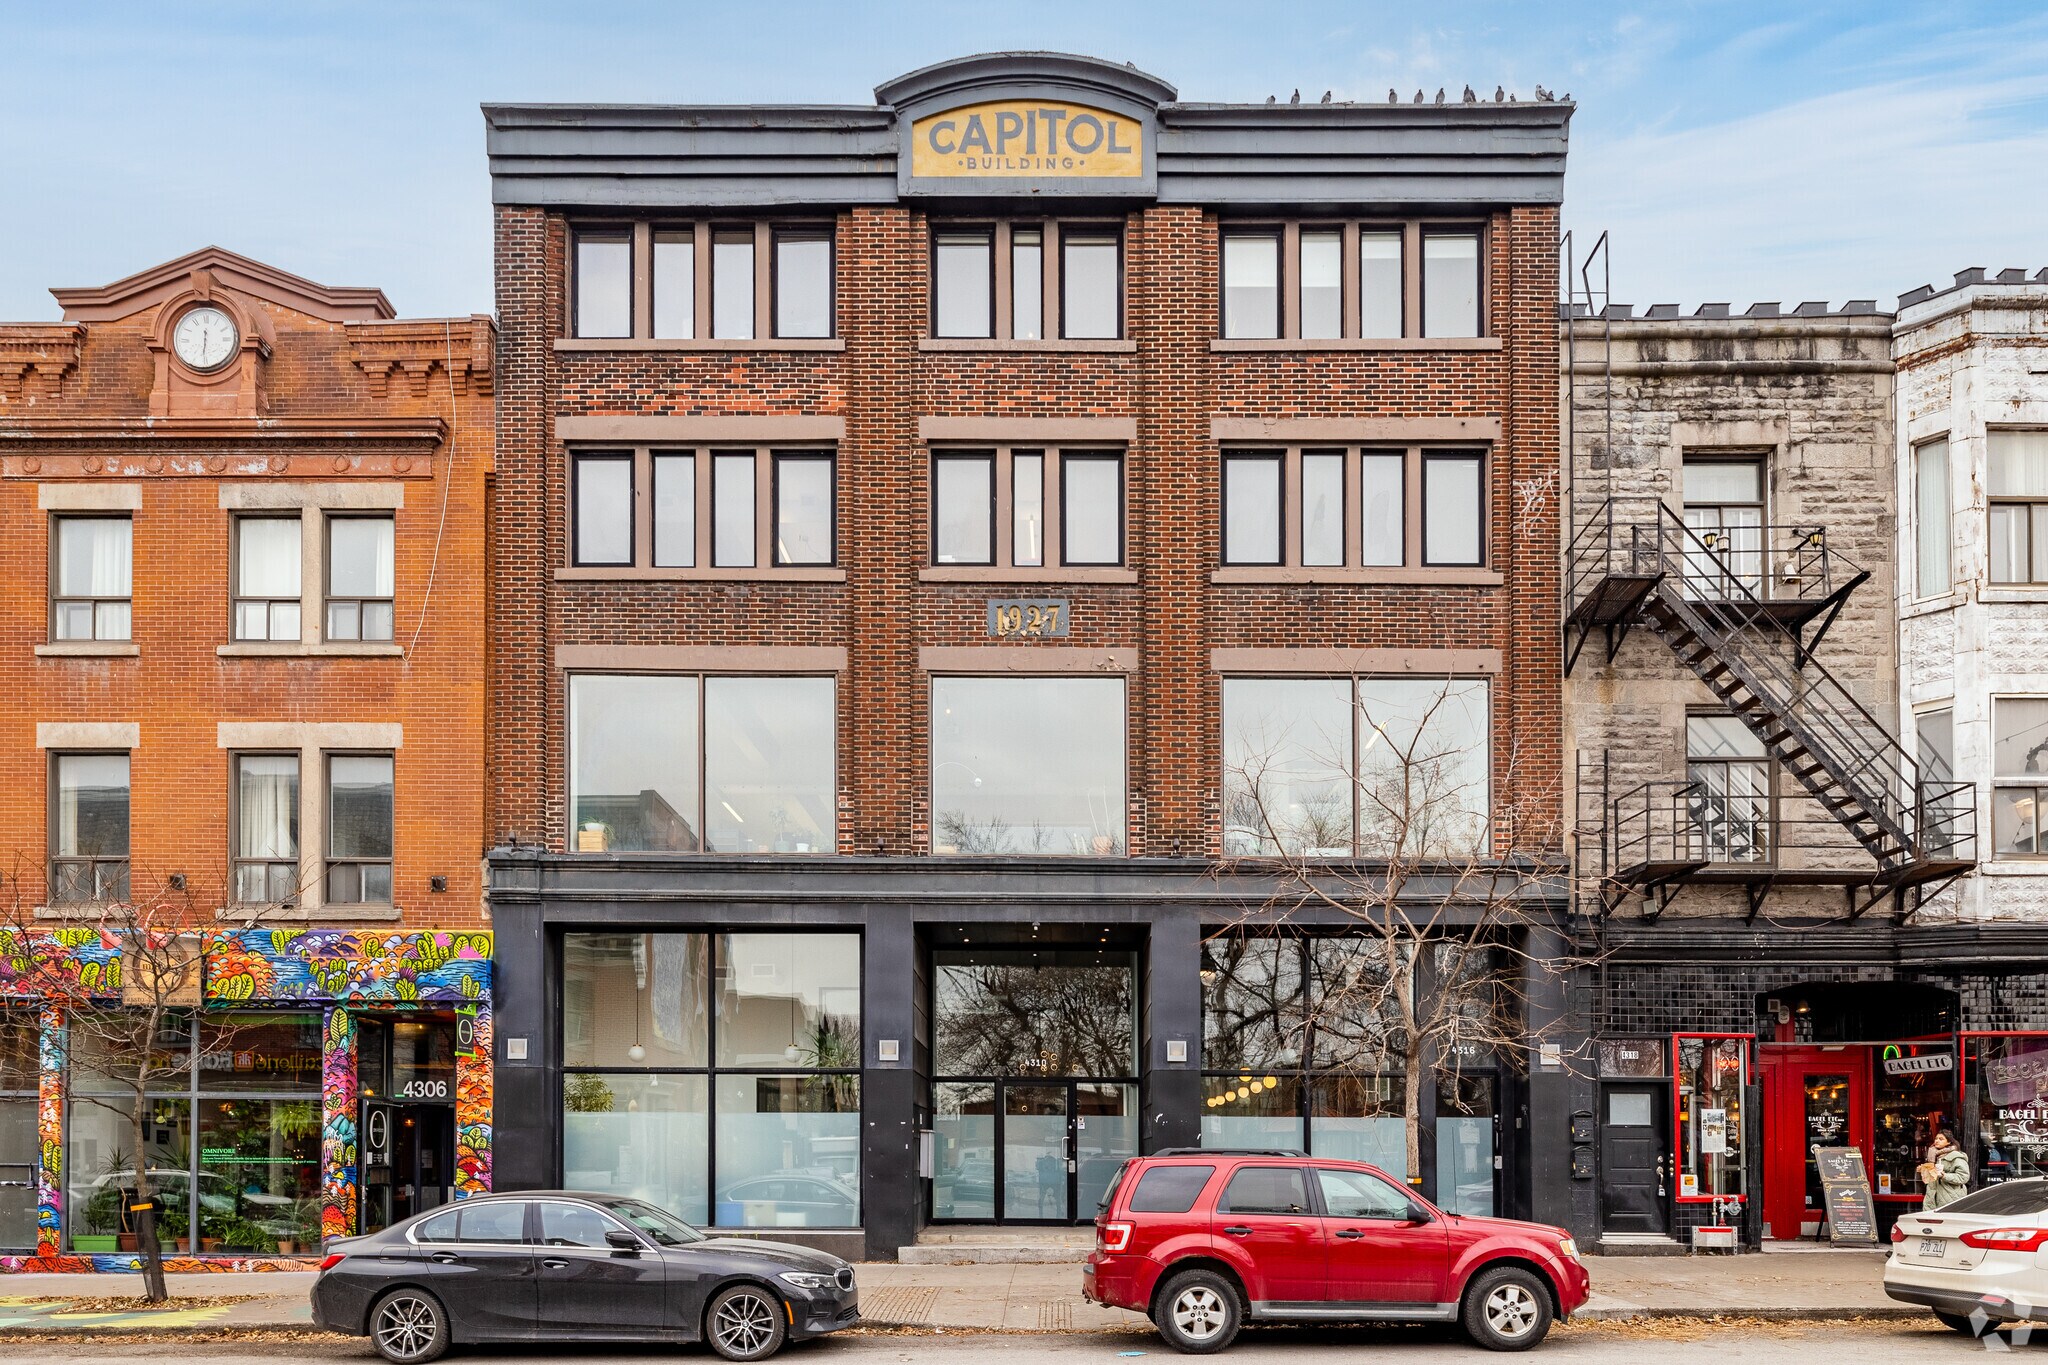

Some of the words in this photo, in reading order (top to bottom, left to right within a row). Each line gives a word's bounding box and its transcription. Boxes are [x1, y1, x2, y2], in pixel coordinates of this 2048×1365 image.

[928, 107, 1131, 155] CAPITOL
[966, 157, 1074, 170] BUILDING
[996, 604, 1060, 633] 1927
[1622, 1051, 1638, 1059] 4318
[1888, 1060, 1925, 1071] BAGEL
[1926, 1057, 1949, 1069] ETC
[403, 1080, 447, 1098] 4306
[1999, 1109, 2039, 1119] BAGEL
